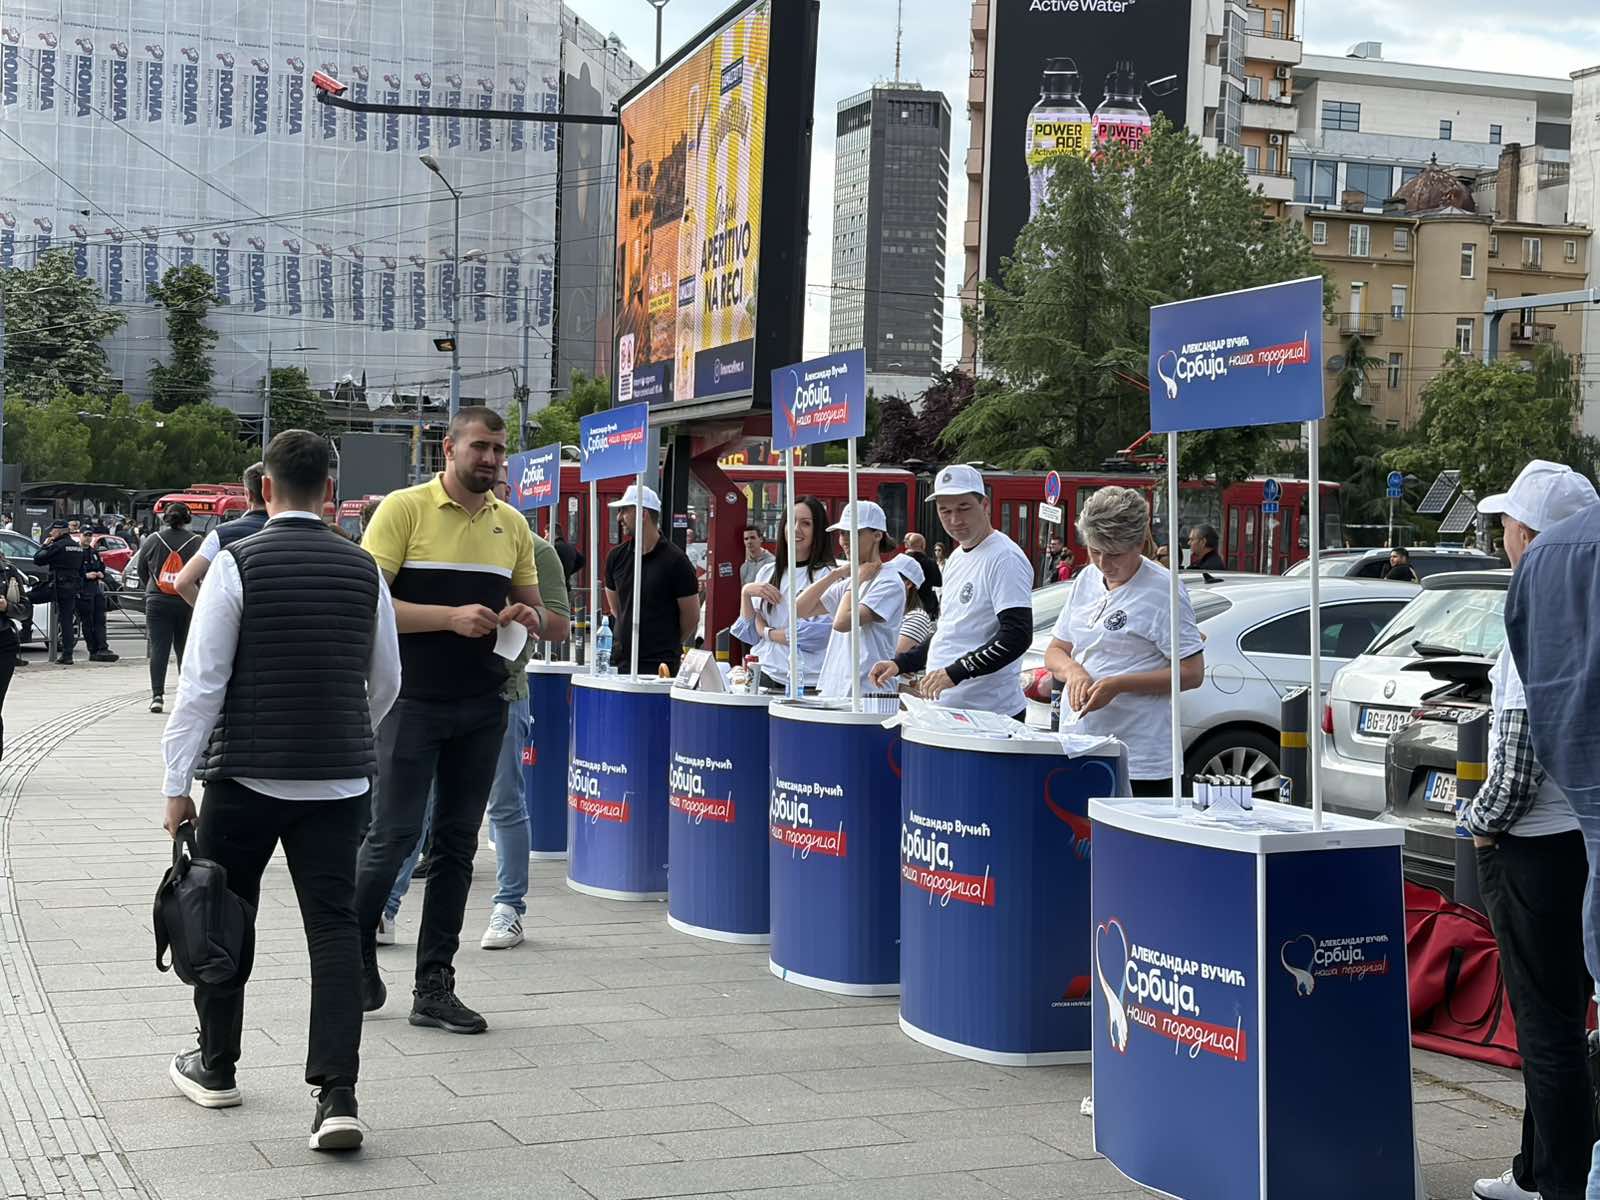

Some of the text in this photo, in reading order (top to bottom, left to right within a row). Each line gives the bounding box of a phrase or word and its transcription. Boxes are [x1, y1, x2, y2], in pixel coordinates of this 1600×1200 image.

[4, 45, 18, 105] ROMA
[41, 50, 55, 111] ROMA
[78, 55, 92, 117] ROMA
[113, 60, 127, 121] ROMA
[149, 62, 163, 122] ROMA
[184, 64, 199, 126] ROMA
[219, 69, 234, 129] ROMA
[253, 75, 268, 135] ROMA
[289, 75, 304, 135] ROMA
[1035, 124, 1082, 136] POWER
[1056, 136, 1082, 148] ADE
[1, 229, 15, 268] ROM
[109, 244, 123, 304] ROMA
[700, 221, 751, 274] APERITIVO
[252, 253, 266, 313] ROMA
[287, 255, 302, 316] ROMA
[320, 259, 335, 319] ROMA
[352, 262, 365, 321] ROMA
[382, 272, 395, 331] ROMA
[413, 271, 426, 330] ROMA
[506, 267, 520, 324] ROMA
[537, 269, 553, 327] ROMA
[704, 276, 718, 313] NA
[720, 267, 744, 309] RECI
[1176, 330, 1308, 383] Србија, наша породица!
[1181, 338, 1226, 354] АЛЕКСАНДАР
[796, 380, 832, 413] Србија,
[1366, 711, 1411, 732] BG 20
[602, 762, 628, 775] Вучић
[705, 757, 733, 771] Вучић
[776, 776, 844, 798] Александар Вучић
[1432, 775, 1450, 799] BG
[580, 792, 626, 824] породица!
[681, 790, 732, 825] породица!
[909, 809, 991, 838] Александар Вучић
[785, 820, 843, 860] породица!
[901, 823, 954, 871] Србија,
[920, 864, 990, 907] породица!
[1131, 944, 1246, 987] АЛЕКСАНДАР ВУЧИЋ
[1314, 945, 1365, 967] Србија,
[1319, 938, 1365, 948] АЛЕКСАНДАР
[1125, 960, 1200, 1016] Србија,
[1126, 1004, 1242, 1061] наша породица!
